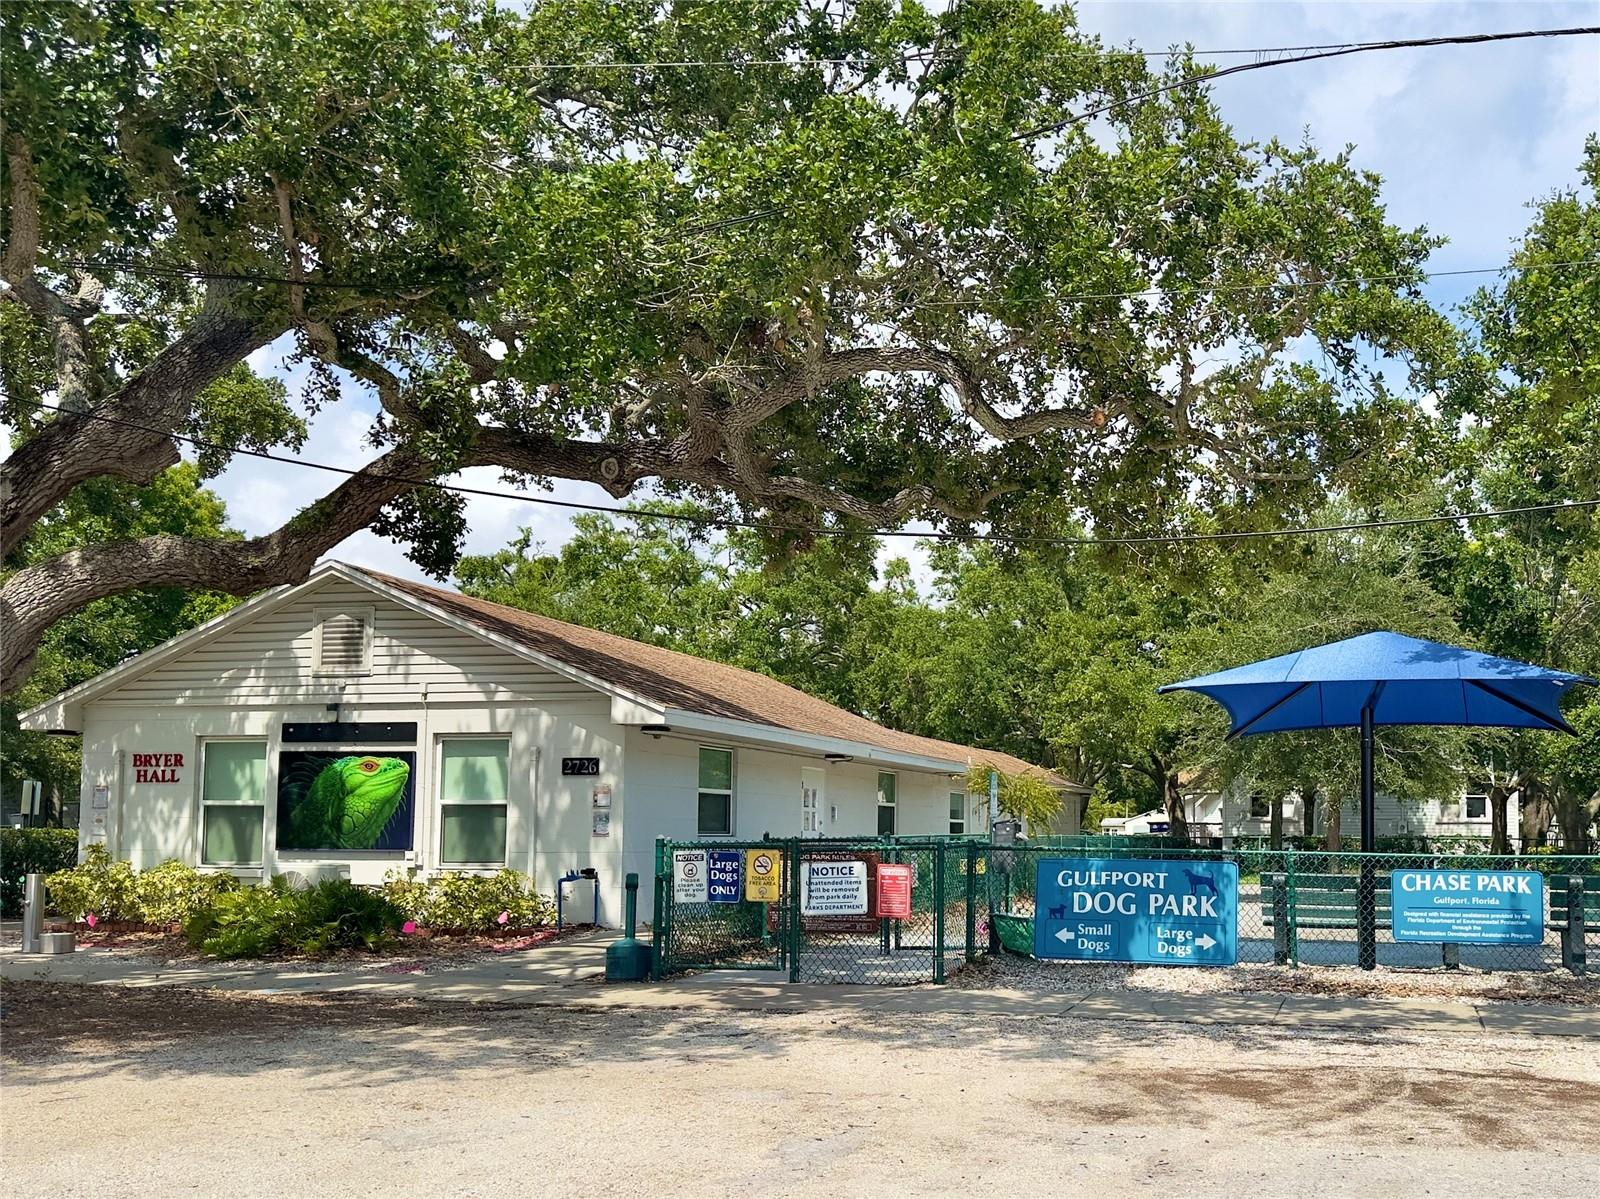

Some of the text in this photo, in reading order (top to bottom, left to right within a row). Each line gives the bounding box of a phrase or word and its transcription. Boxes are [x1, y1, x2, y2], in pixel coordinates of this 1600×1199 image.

[132, 753, 184, 768] BRYER
[563, 760, 597, 774] 2726
[135, 769, 181, 783] HALL
[676, 854, 703, 862] NOTICE
[710, 860, 739, 871] Large
[811, 866, 855, 877] NOTICE
[711, 871, 738, 882] Dogs
[1057, 870, 1168, 888] GULFPORT
[710, 885, 737, 895] ONLY
[1401, 873, 1532, 895] CHASE PARK
[826, 893, 841, 901] park
[1433, 897, 1500, 905] Gulfport, Florida
[824, 903, 864, 911] DEPARTMENT
[1073, 892, 1218, 918] DOG PARK
[1077, 924, 1112, 936] Small
[1156, 927, 1193, 944] Large
[1077, 938, 1110, 953] Dogs
[1157, 942, 1193, 958] Dogs
